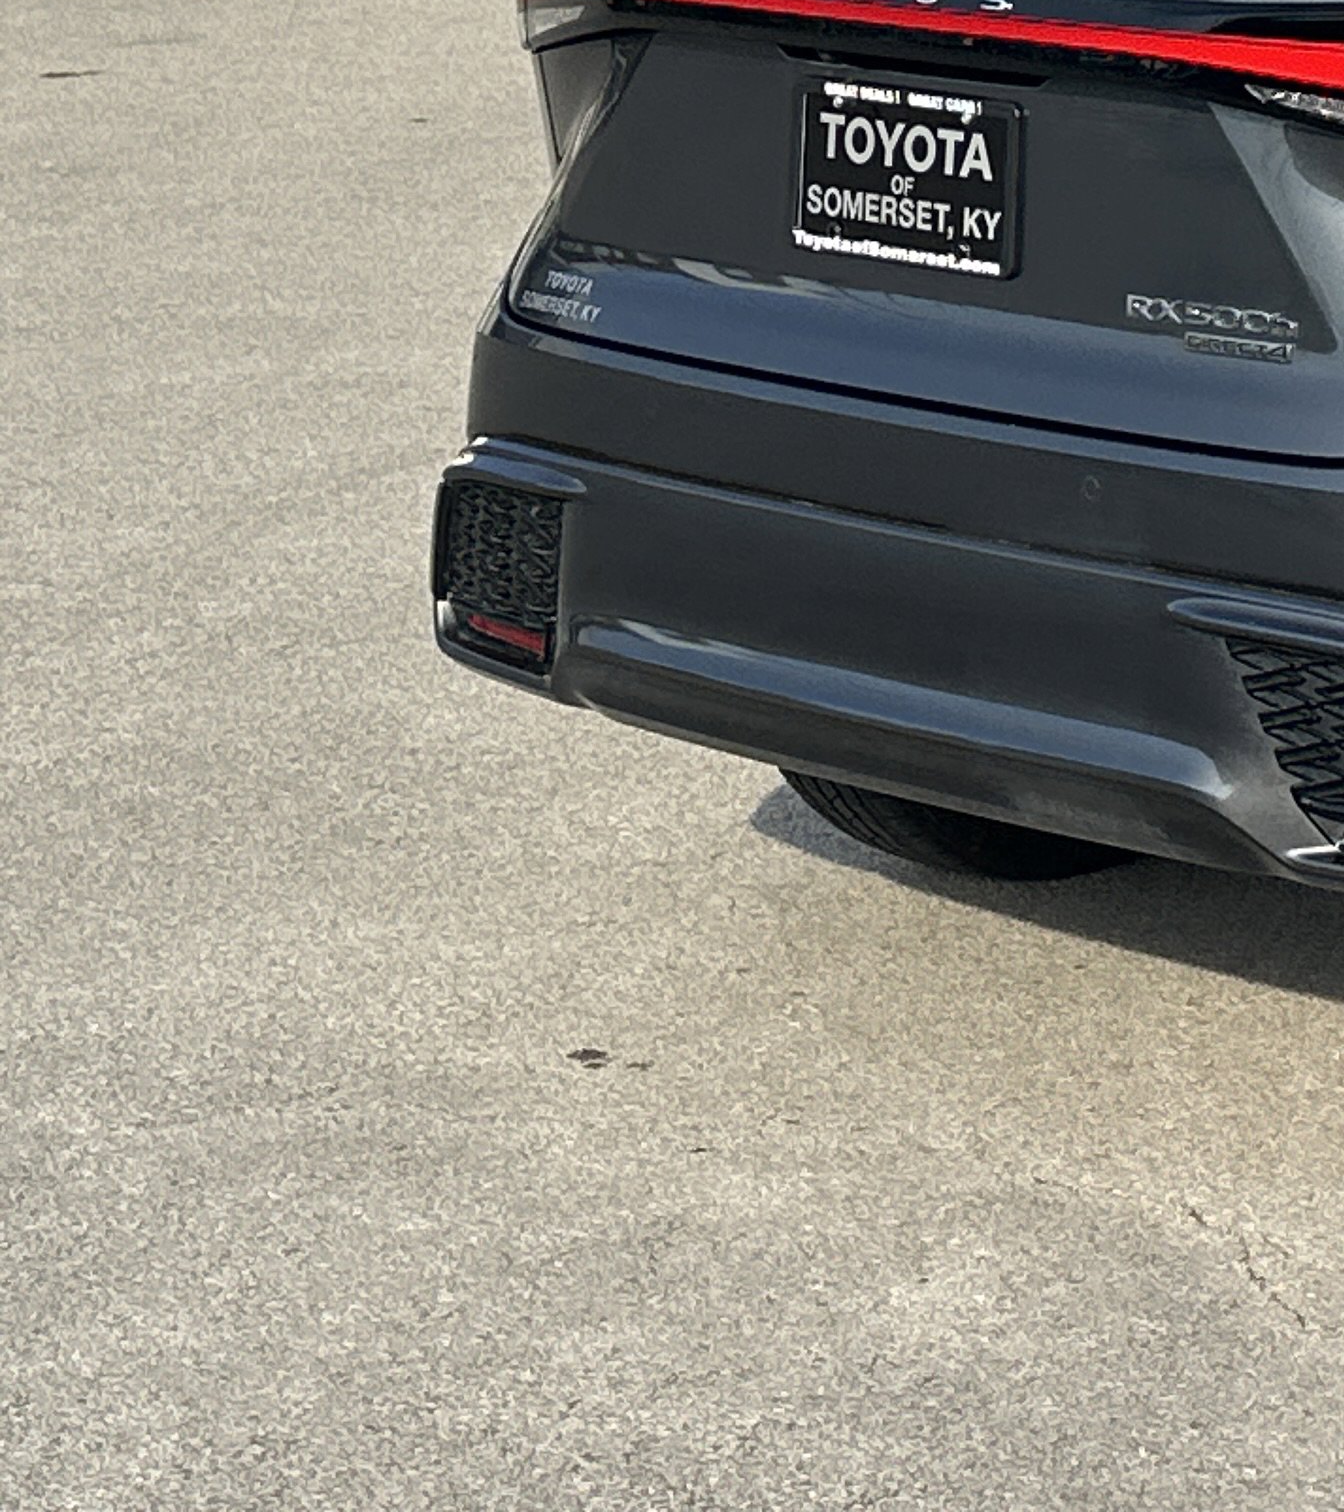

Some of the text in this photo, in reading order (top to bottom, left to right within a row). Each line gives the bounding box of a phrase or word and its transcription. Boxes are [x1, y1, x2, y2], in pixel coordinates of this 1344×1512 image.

[820, 112, 993, 182] TOYOTA
[890, 174, 915, 197] OF
[806, 184, 1001, 241] SOMERSET, KY
[545, 270, 594, 296] TOYOTA
